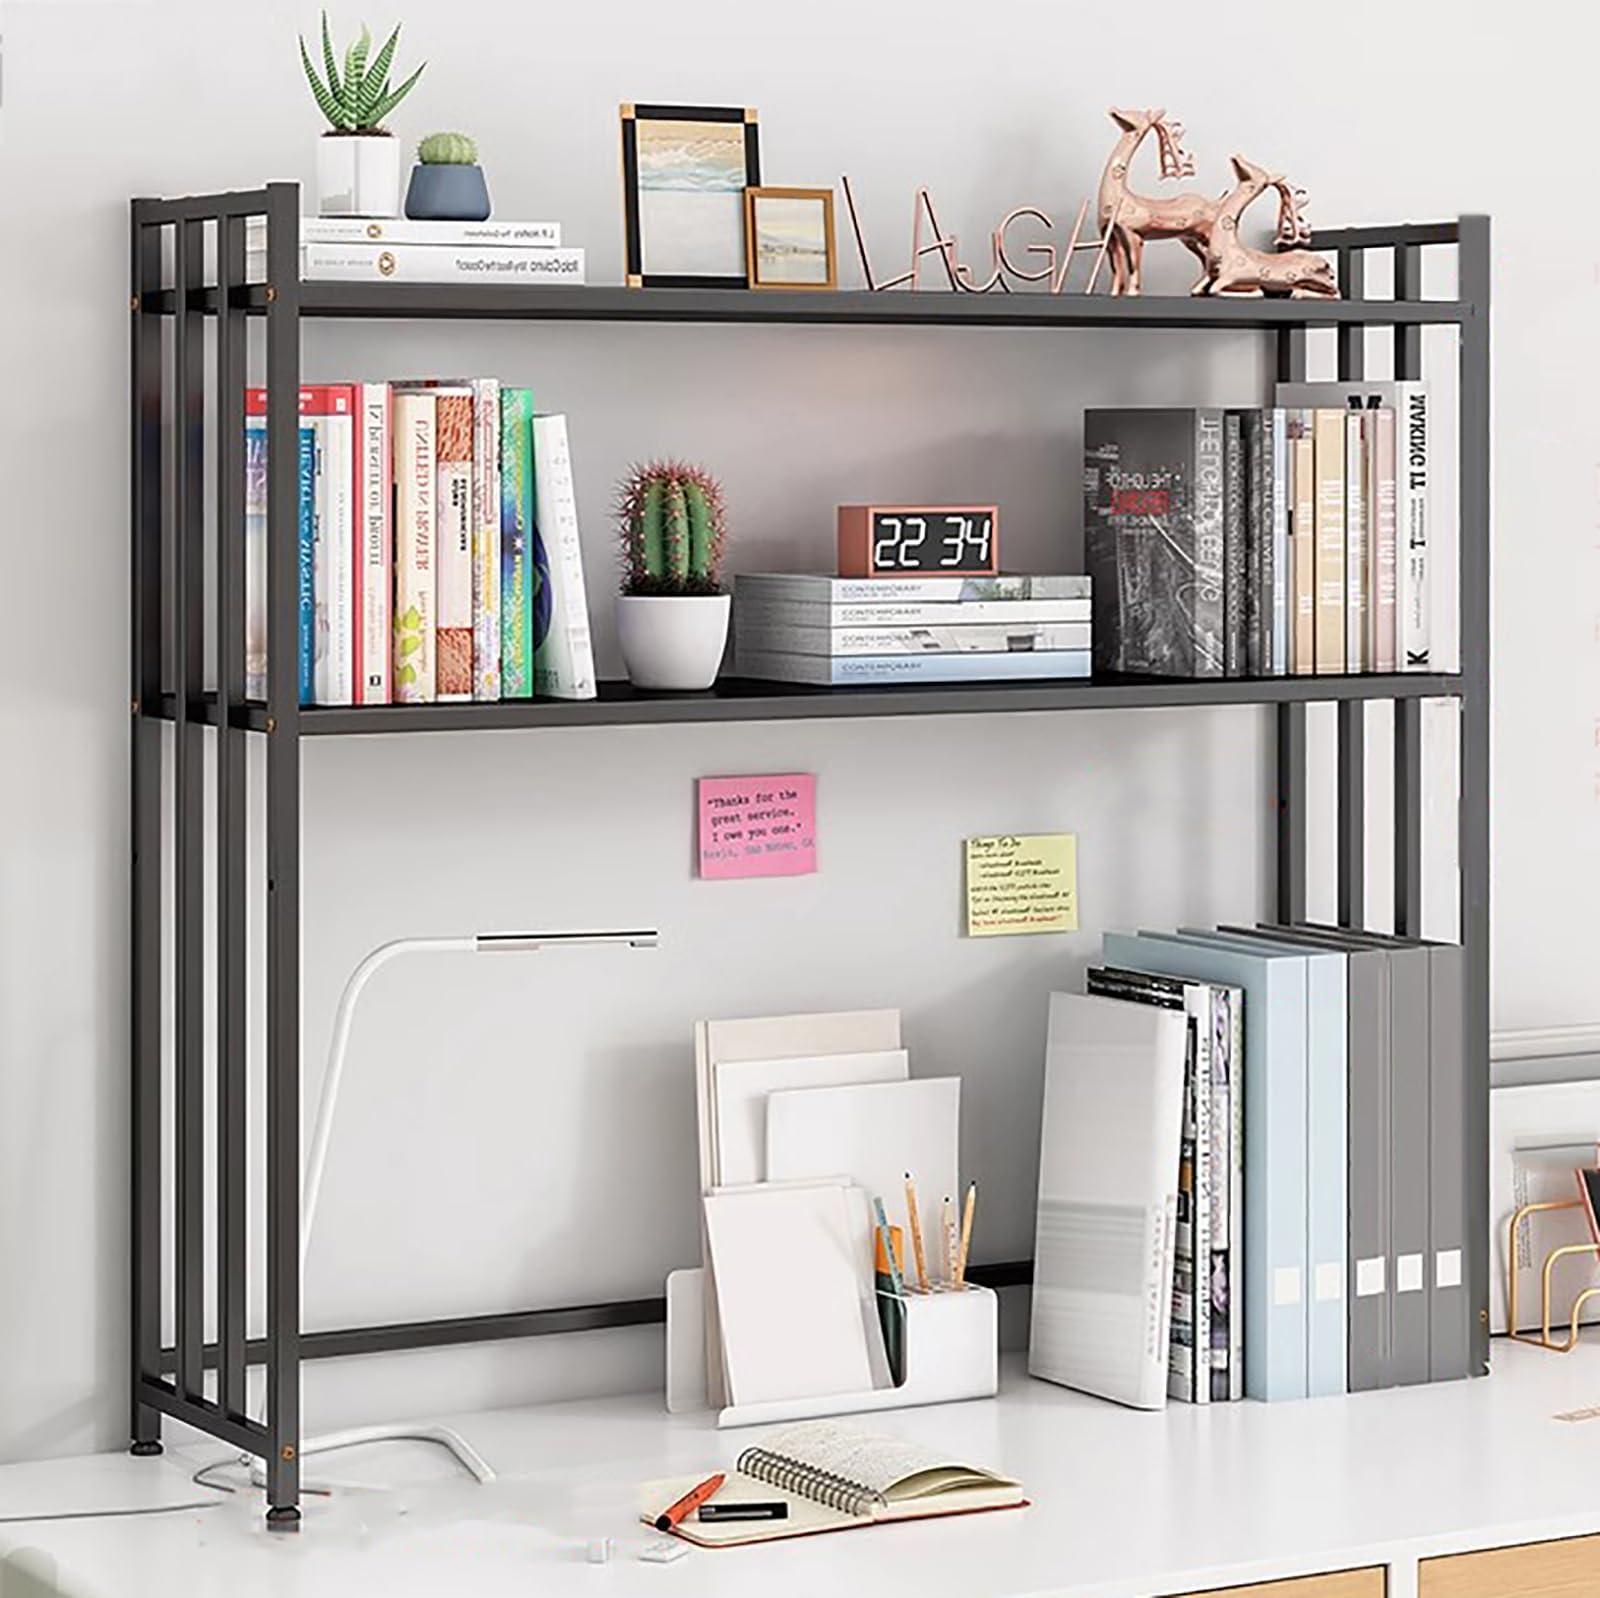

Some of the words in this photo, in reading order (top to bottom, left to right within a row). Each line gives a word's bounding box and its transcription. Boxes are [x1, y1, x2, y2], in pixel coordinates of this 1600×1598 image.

[875, 517, 926, 567] 22
[940, 516, 991, 567] 34
[755, 792, 774, 804] for
[778, 789, 798, 801] the
[711, 813, 742, 828] great
[723, 830, 743, 842] owe
[747, 827, 768, 841] you
